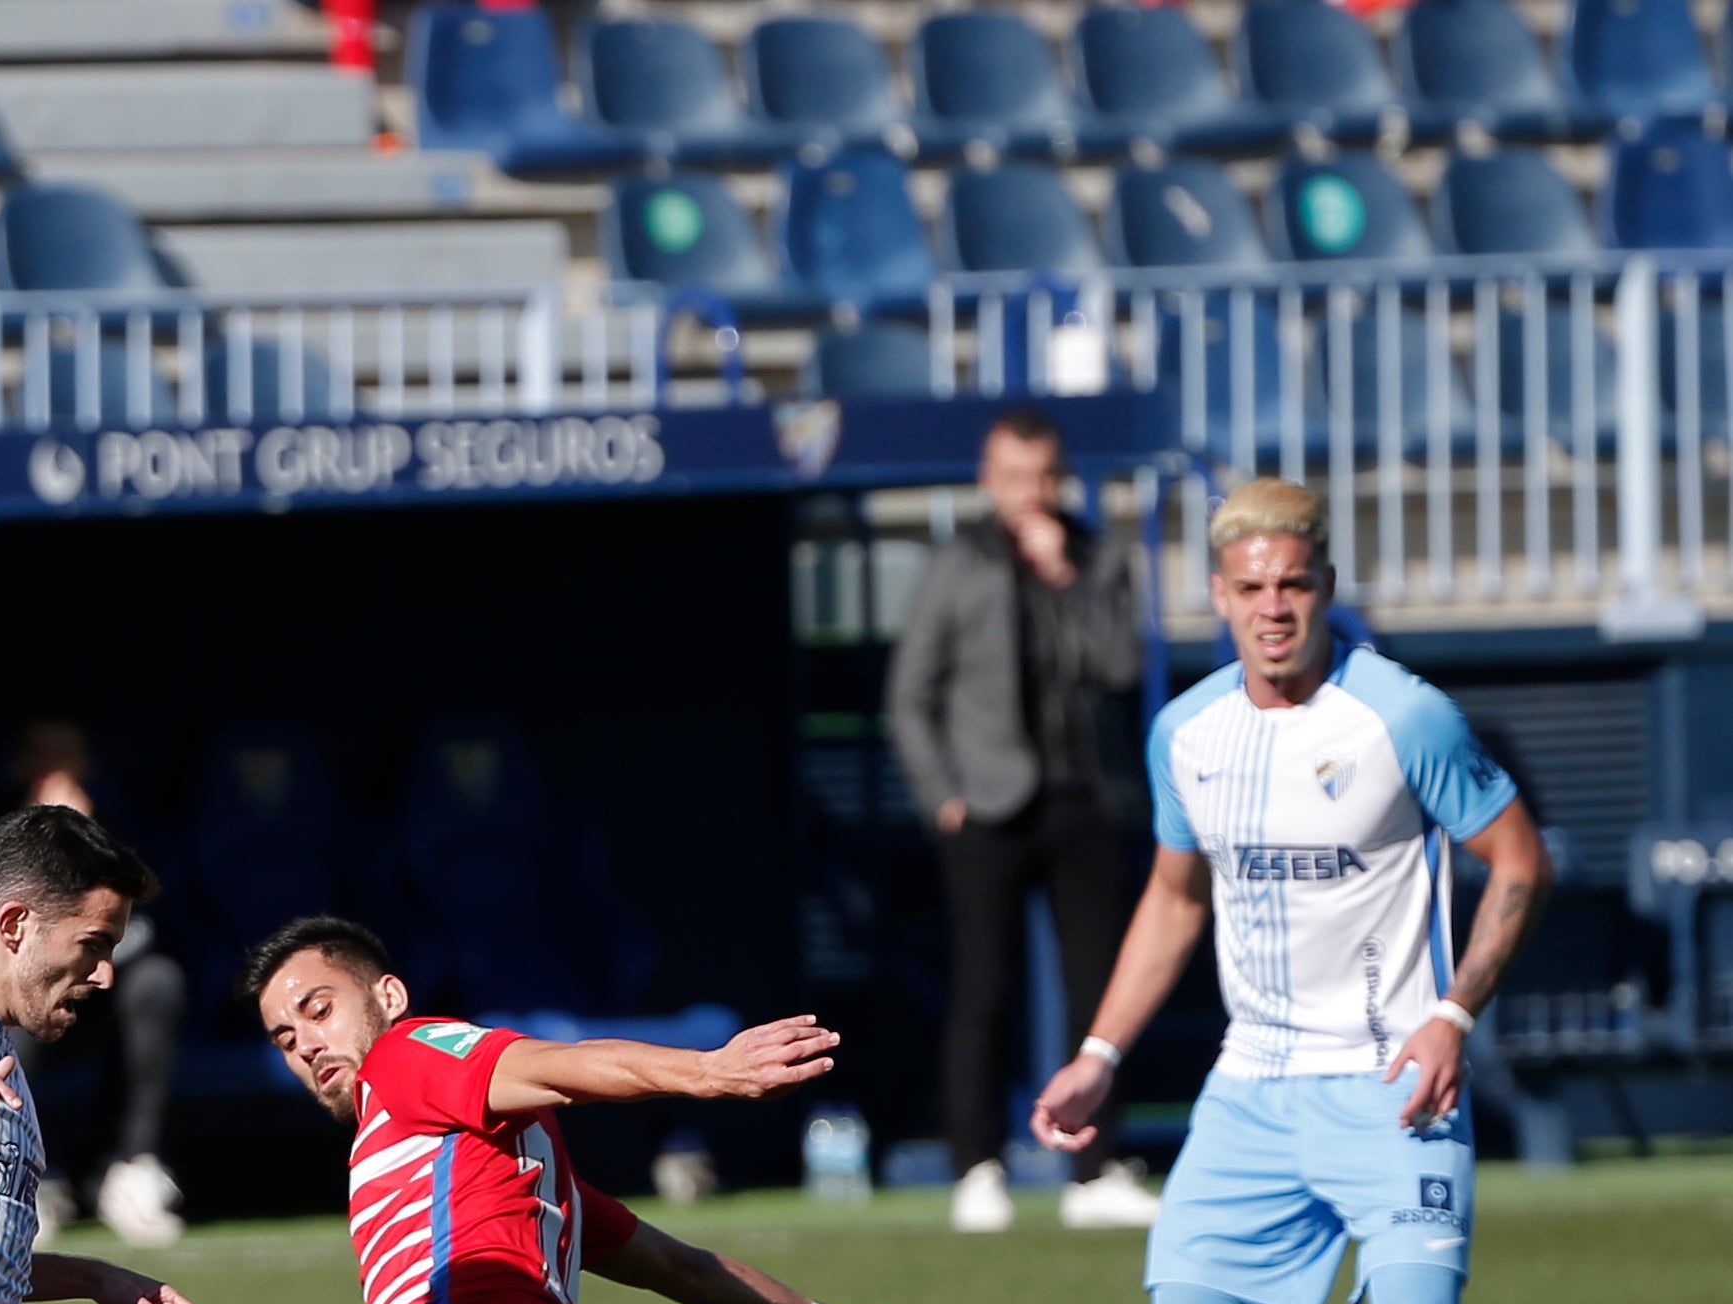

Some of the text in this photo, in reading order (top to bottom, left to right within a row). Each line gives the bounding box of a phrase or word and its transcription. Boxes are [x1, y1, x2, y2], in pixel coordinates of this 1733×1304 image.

[97, 415, 664, 500] PONT GRUP SEGUROS
[1233, 842, 1370, 881] TESESA
